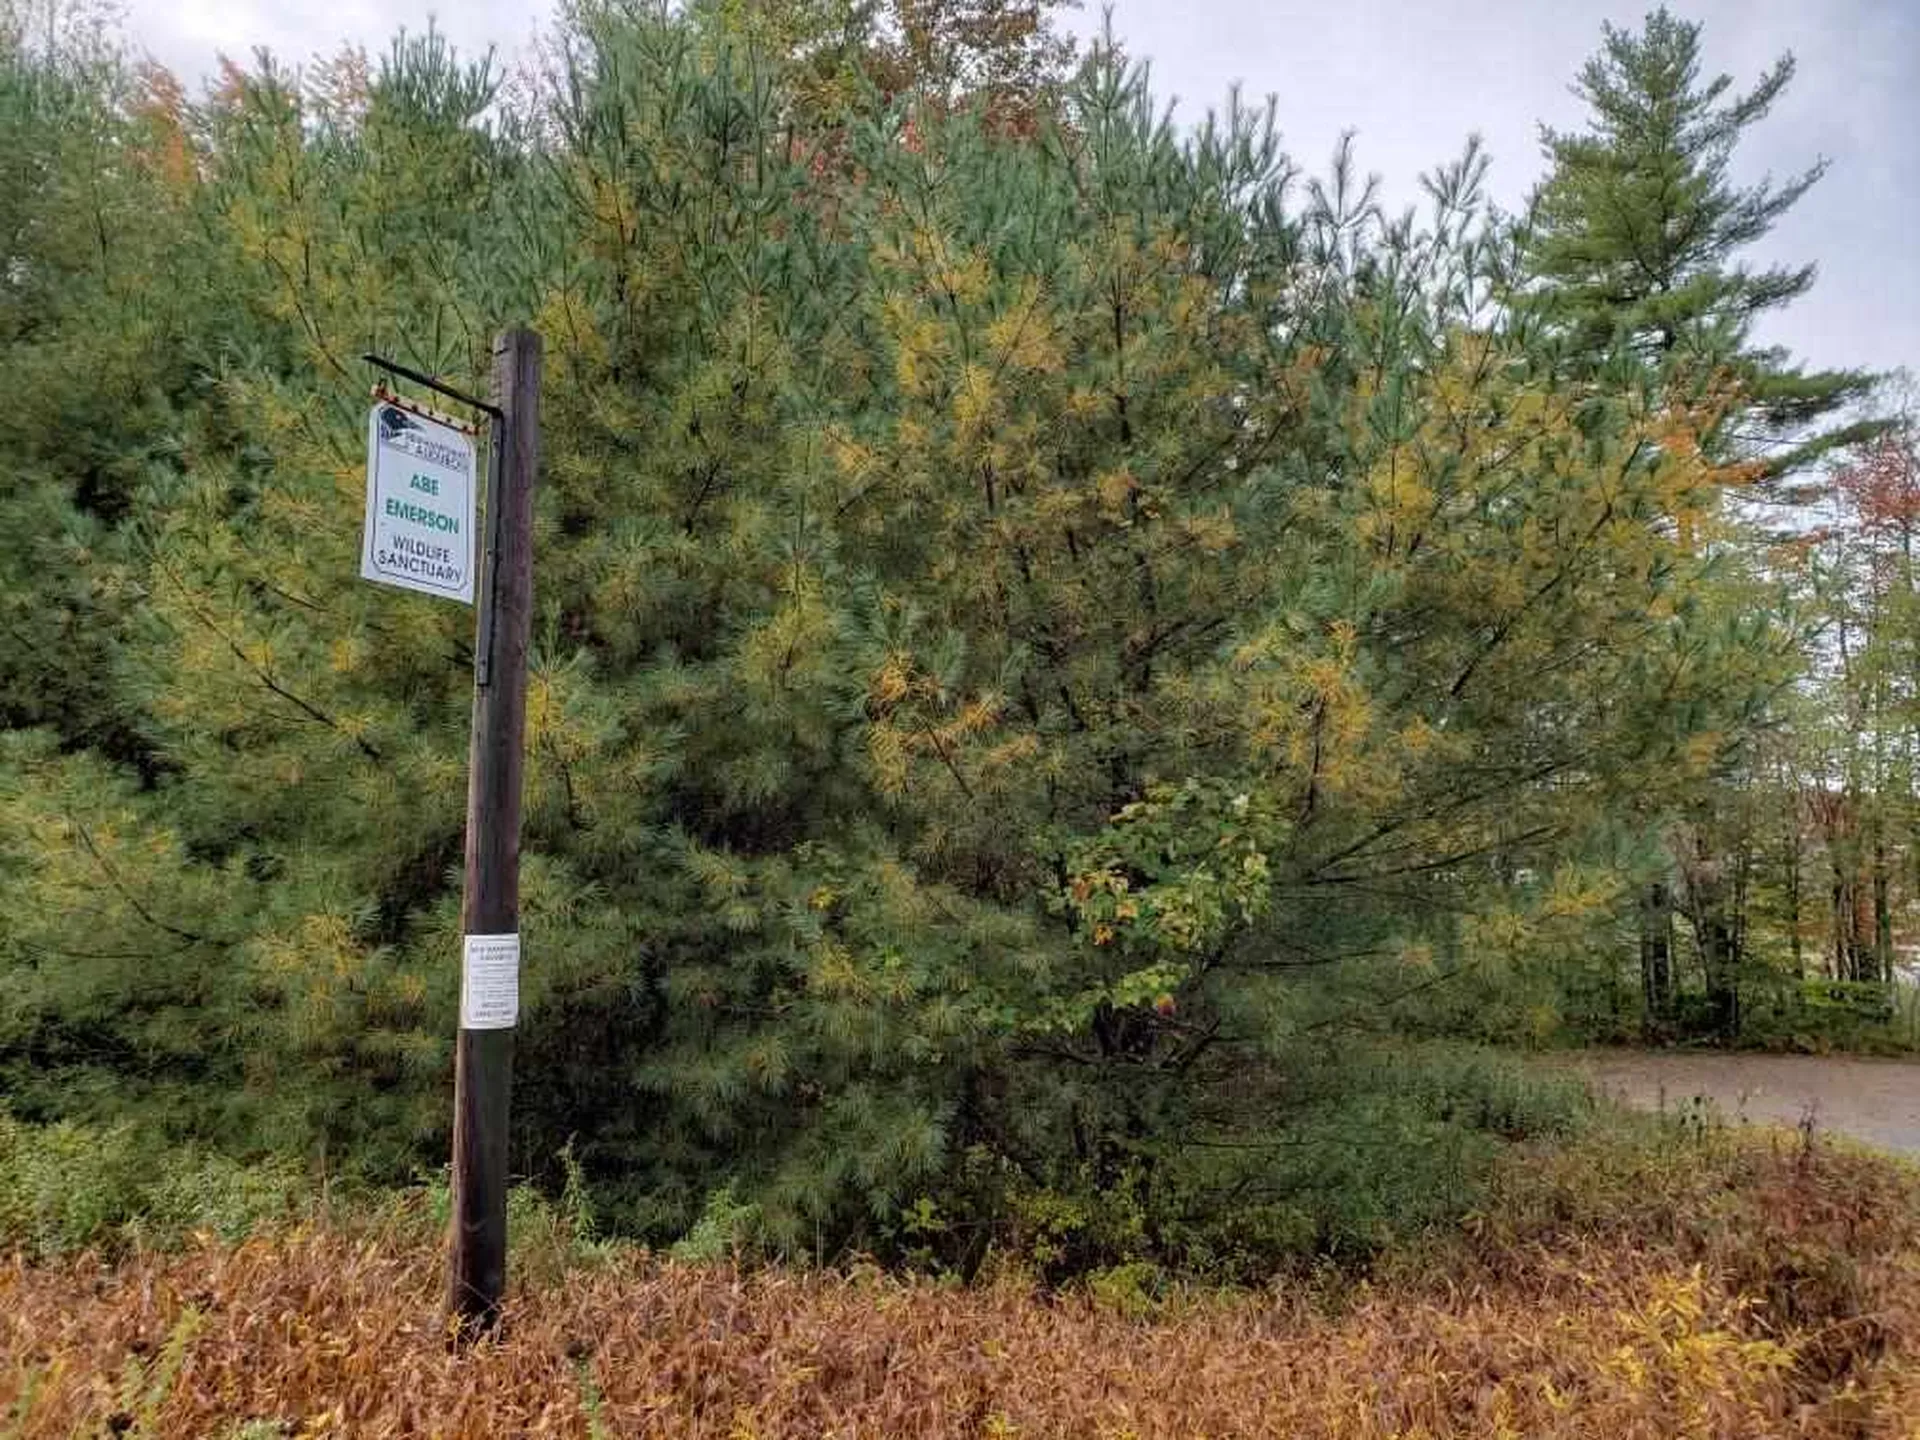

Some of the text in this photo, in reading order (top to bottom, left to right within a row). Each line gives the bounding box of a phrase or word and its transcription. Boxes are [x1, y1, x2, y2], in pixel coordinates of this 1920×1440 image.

[410, 474, 439, 496] ABE
[386, 499, 459, 533] EMERSON
[393, 535, 450, 563] WILDLIFE
[379, 549, 462, 582] SANCTUARY
